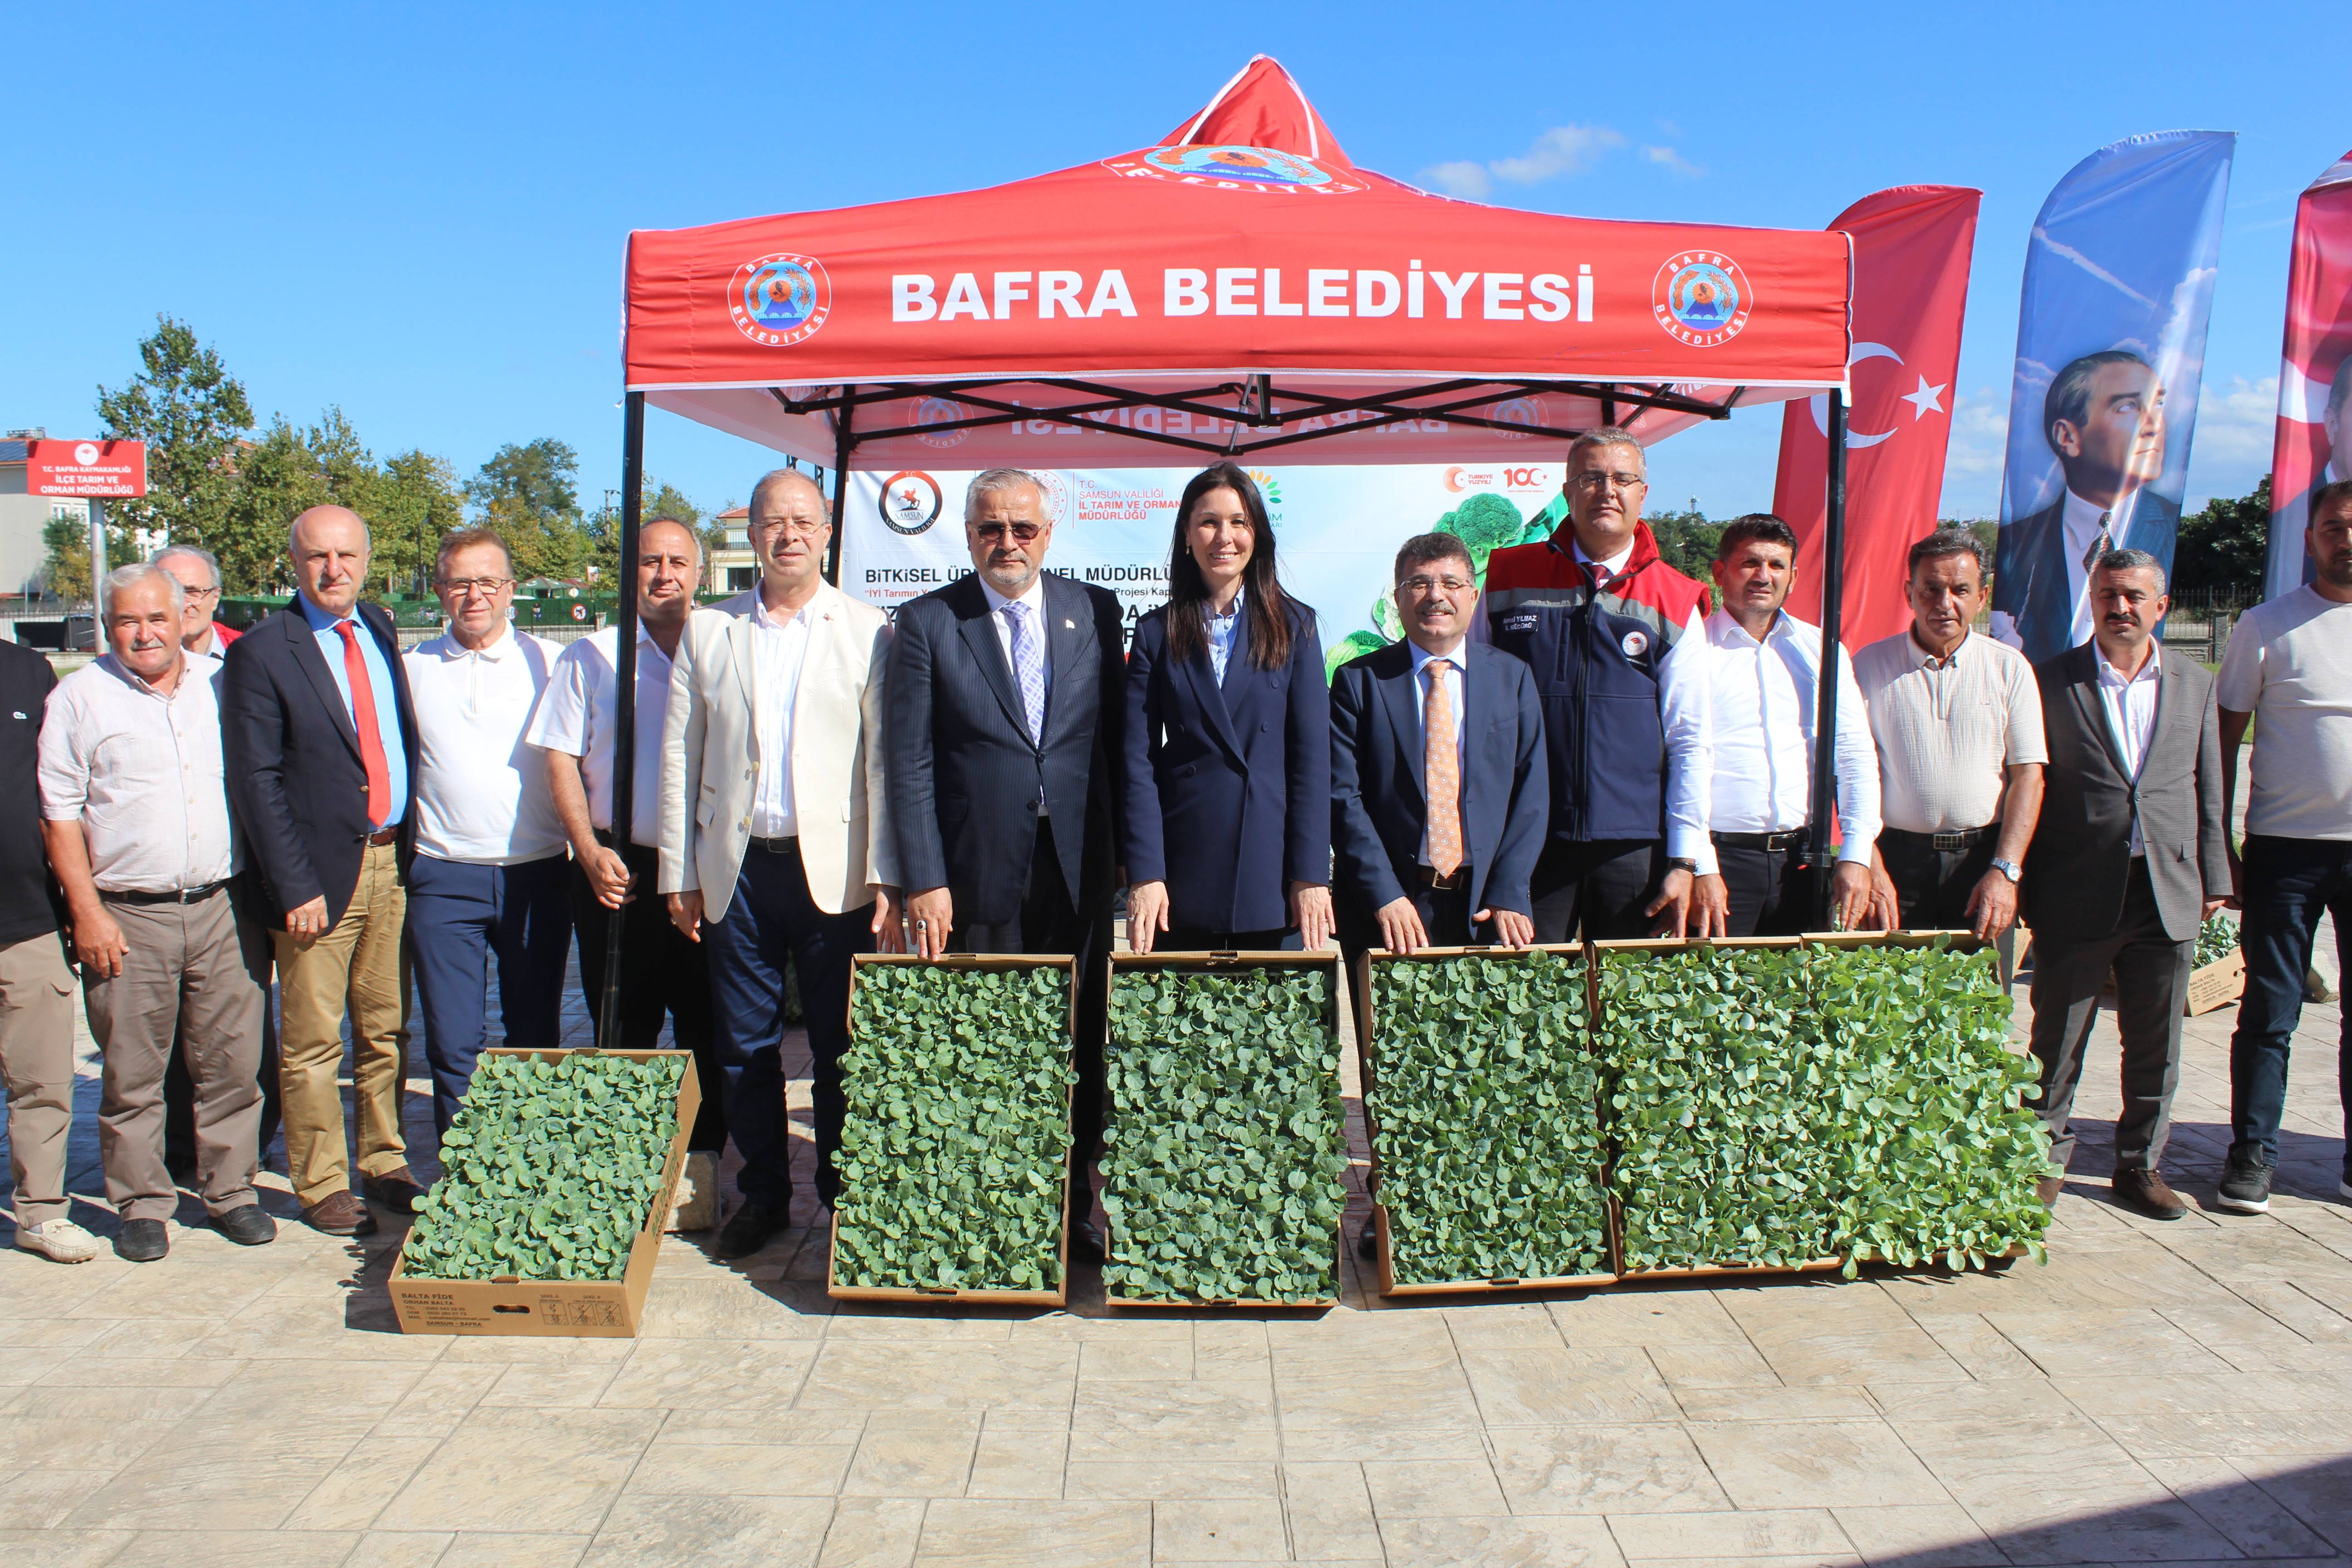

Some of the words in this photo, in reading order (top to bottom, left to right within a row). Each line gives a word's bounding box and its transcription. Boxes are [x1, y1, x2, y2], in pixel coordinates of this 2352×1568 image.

[1669, 253, 1735, 275] BAFRA
[892, 270, 1138, 322] BAFRA
[1164, 259, 1594, 322] BELEDİYESİ
[732, 305, 828, 344] BELEDİYESİ
[1656, 304, 1747, 345] BELEDİYESİ
[55, 475, 75, 484] İLÇE
[1078, 480, 1097, 489] T.C.
[40, 485, 74, 494] ORMAN
[77, 484, 134, 495] MÜDÜRLÜĞÜ
[1079, 491, 1121, 499] SAMSUN
[1124, 488, 1164, 499] VALİLİĞİ
[1078, 500, 1088, 510] İL
[1091, 501, 1123, 510] TARIM
[1126, 500, 1140, 509] VE
[894, 511, 924, 521] SAMSUN
[1078, 510, 1147, 520] MÜDÜRLÜĞÜ
[886, 518, 909, 534] SAMSUN
[884, 589, 918, 598] Tarımın
[1114, 588, 1148, 598] Projesi
